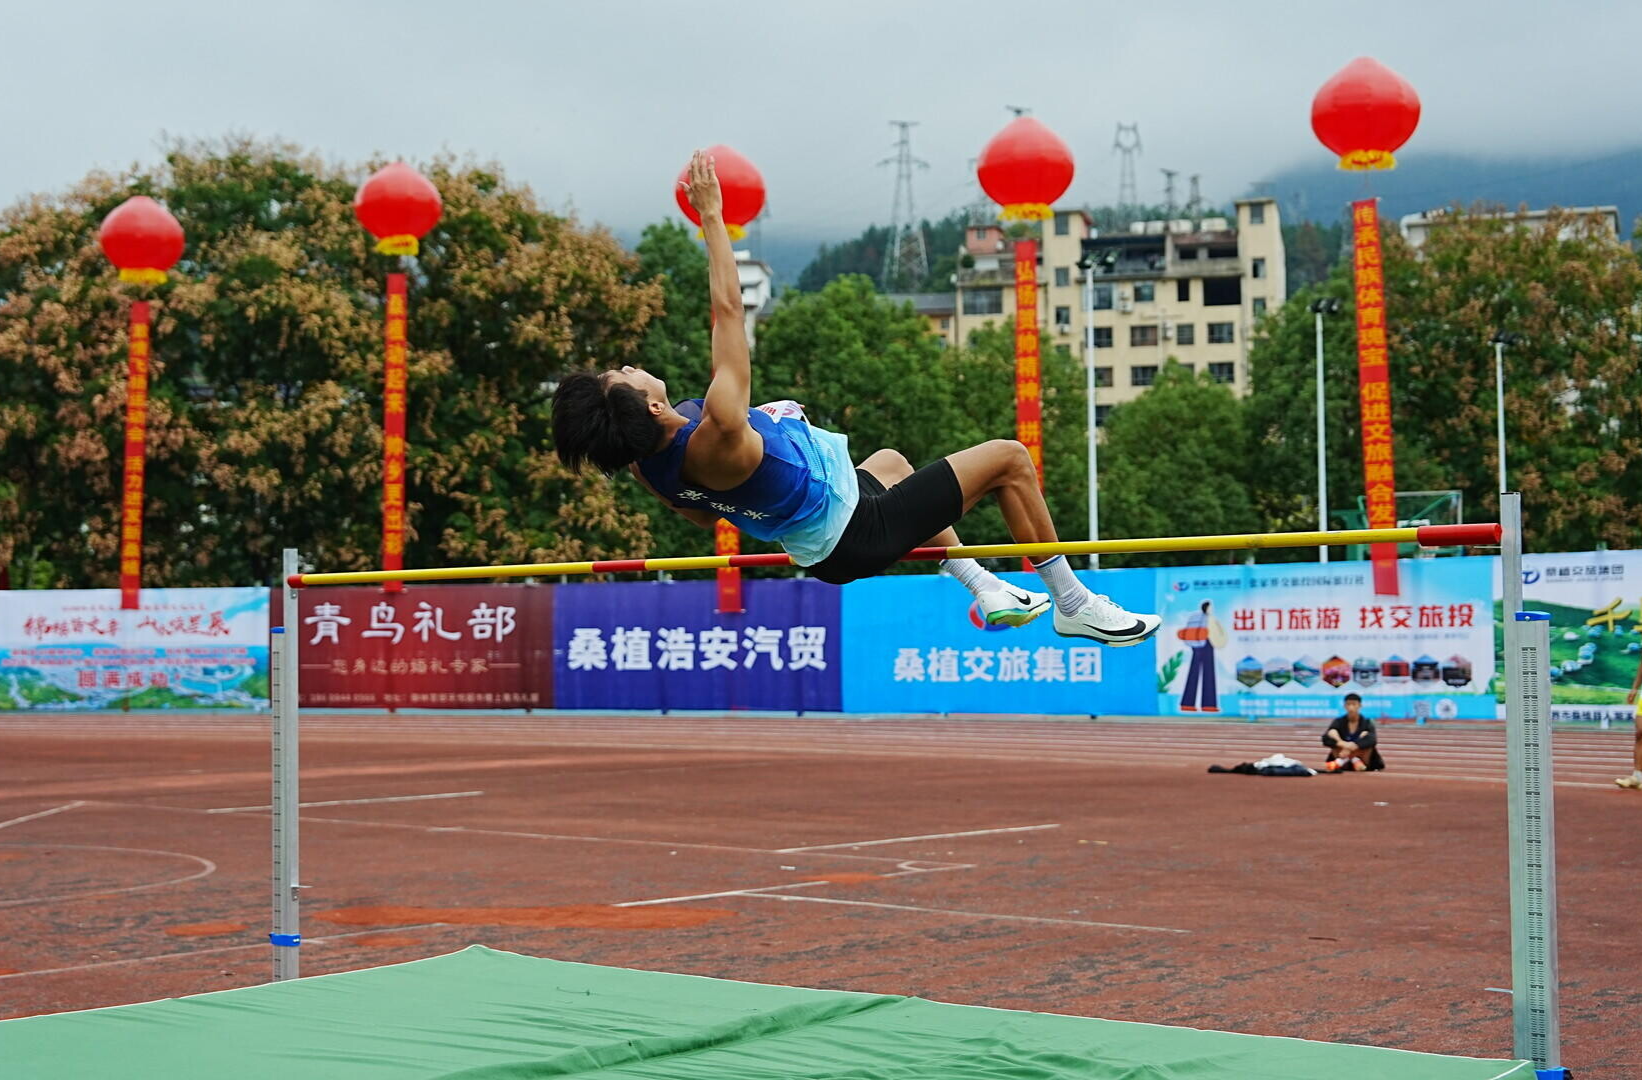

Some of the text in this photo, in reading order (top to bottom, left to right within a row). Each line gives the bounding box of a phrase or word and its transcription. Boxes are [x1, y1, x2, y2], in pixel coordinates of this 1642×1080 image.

[1361, 381, 1397, 530] 促进文旅融合发
[304, 601, 517, 645] 青鸟礼部
[1233, 603, 1475, 631] 出门旅游 找交旅投
[331, 657, 490, 676] 您身边的婚礼专家
[567, 626, 828, 671] 桑植浩安汽贸
[893, 646, 1103, 682] 桑植交旅集团
